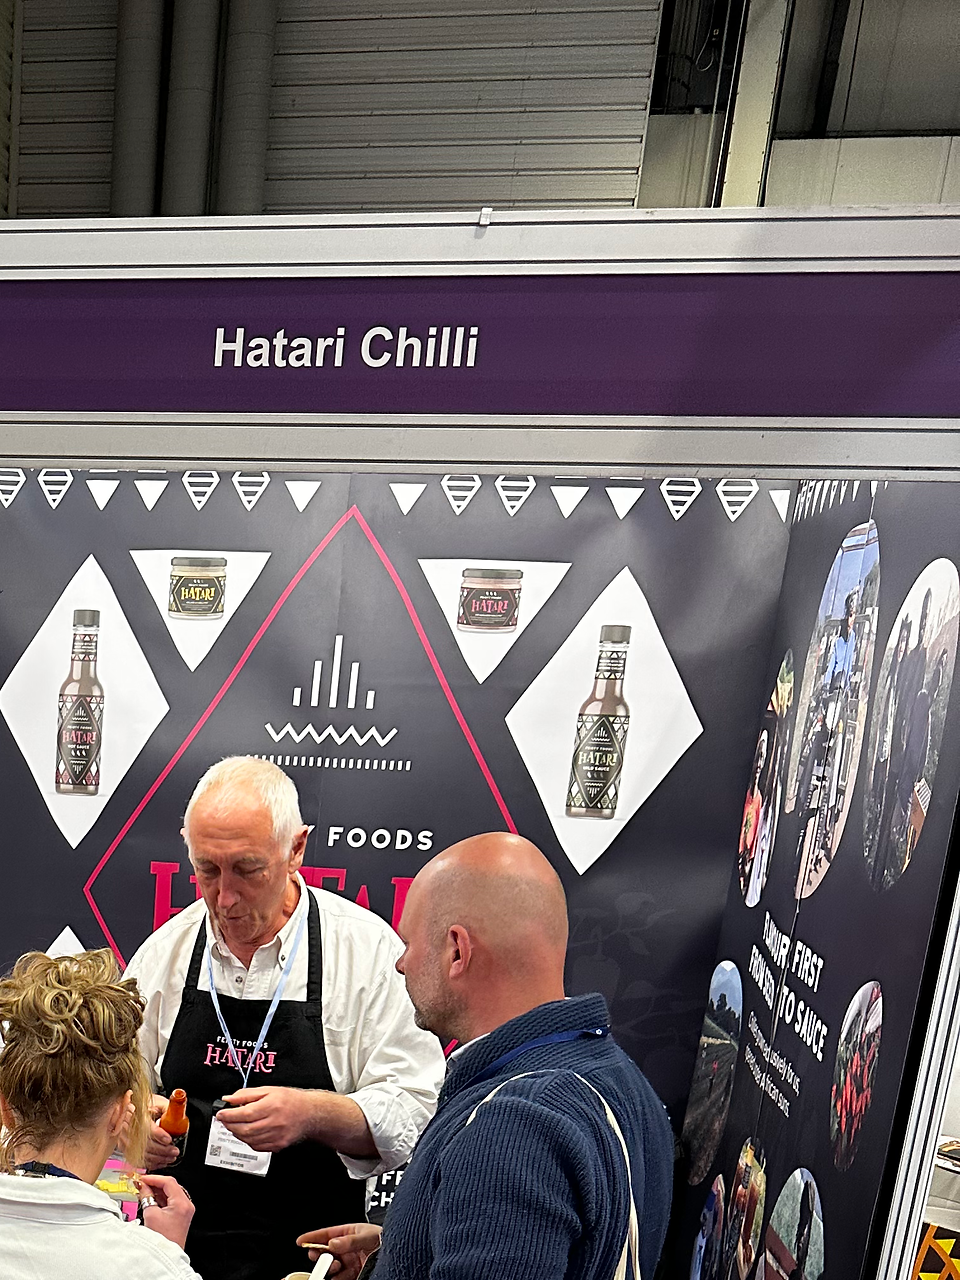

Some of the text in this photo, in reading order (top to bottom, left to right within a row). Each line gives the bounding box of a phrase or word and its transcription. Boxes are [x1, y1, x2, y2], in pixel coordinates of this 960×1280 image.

[214, 327, 478, 367] Hatari Chilli
[181, 587, 216, 601] HATARI
[471, 599, 509, 614] HATARI
[62, 731, 97, 744] HATARI
[578, 752, 618, 767] HATARI
[327, 825, 434, 851] FOODS
[792, 940, 824, 993] FIRST
[748, 944, 764, 991] FROM
[779, 985, 796, 1025] TO
[794, 1000, 828, 1062] SAUCE
[203, 1043, 277, 1073] HATARI
